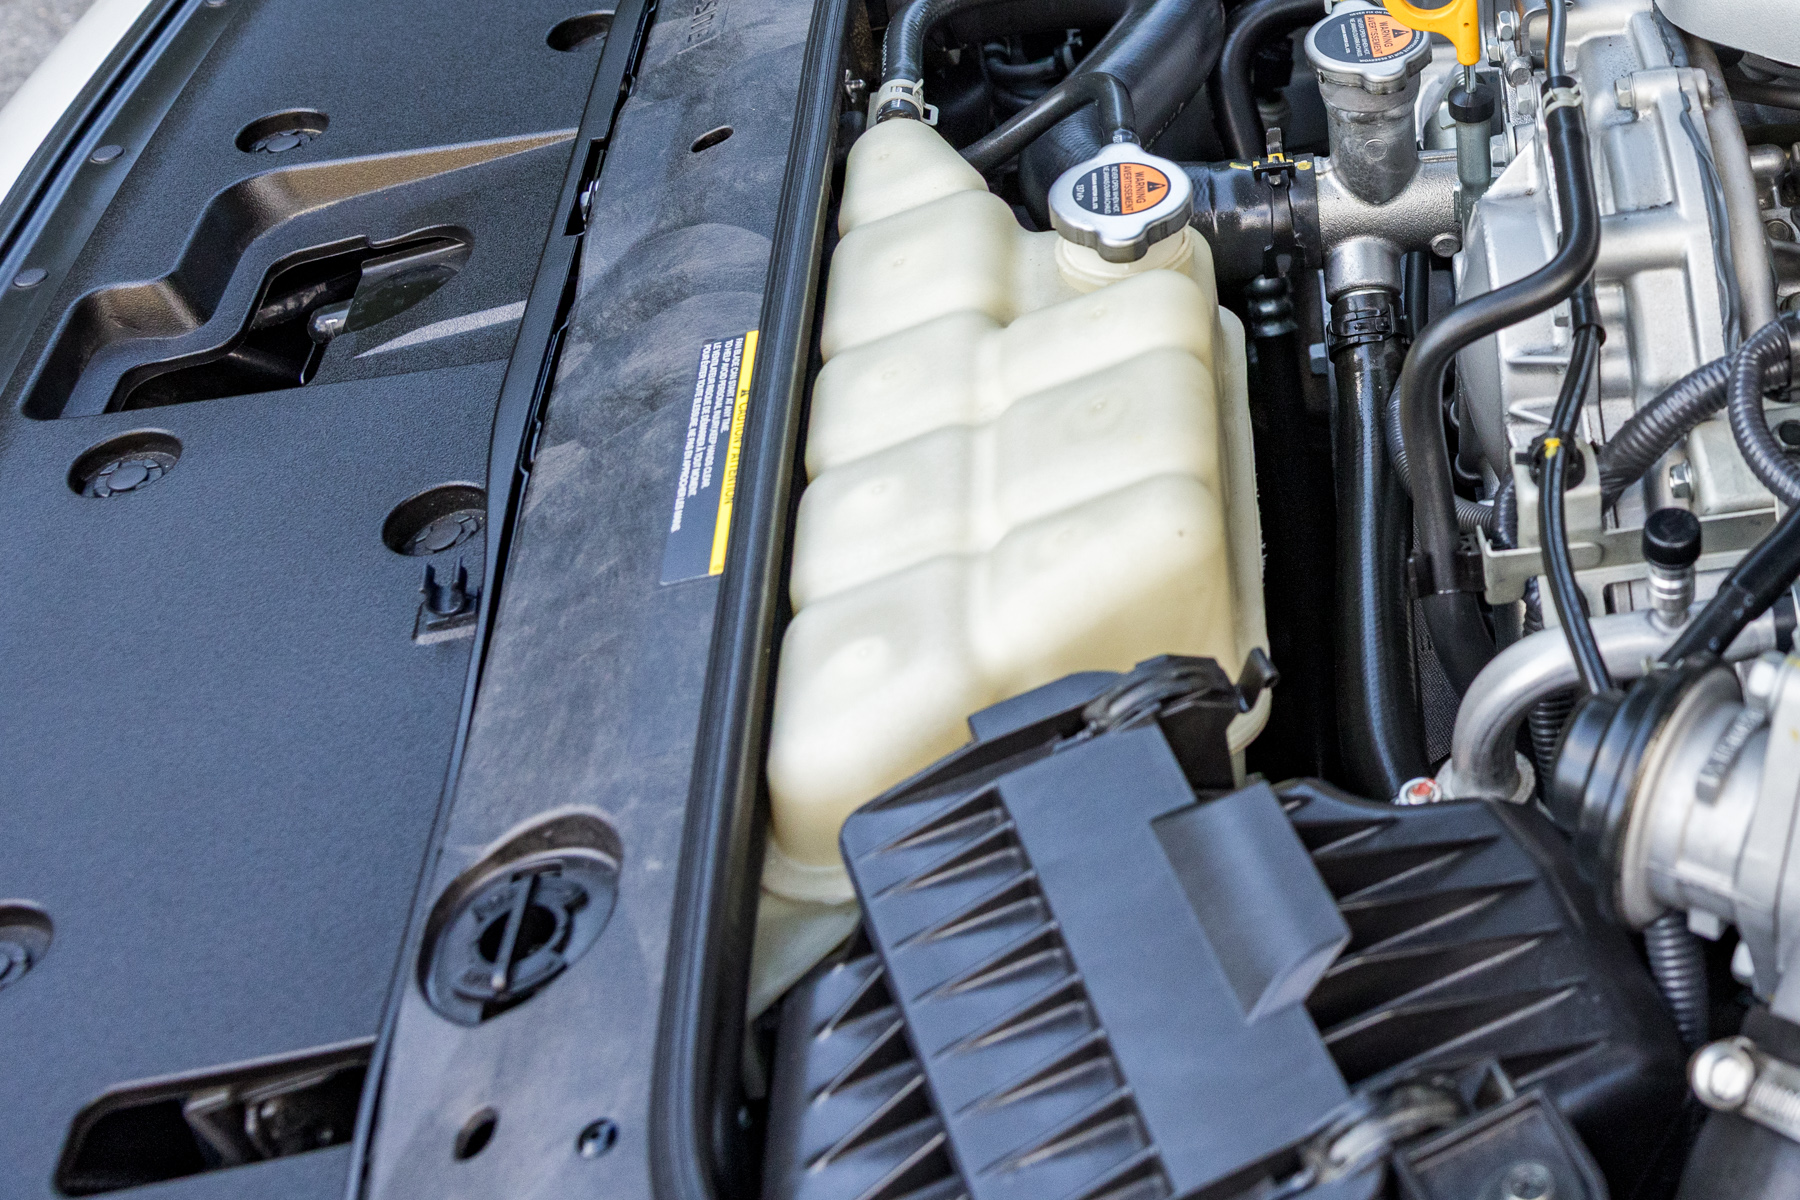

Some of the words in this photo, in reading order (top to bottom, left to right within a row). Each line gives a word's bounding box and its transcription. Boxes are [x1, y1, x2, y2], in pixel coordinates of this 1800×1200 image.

[1366, 16, 1382, 54] AVERTISSEMENT
[1379, 21, 1393, 47] WARNING
[1123, 165, 1133, 211] AVERTISSEMENT
[1134, 171, 1145, 203] WARNING
[729, 366, 738, 379] CAN
[734, 402, 747, 443] CAUTION
[724, 453, 740, 505] ATTENTION
